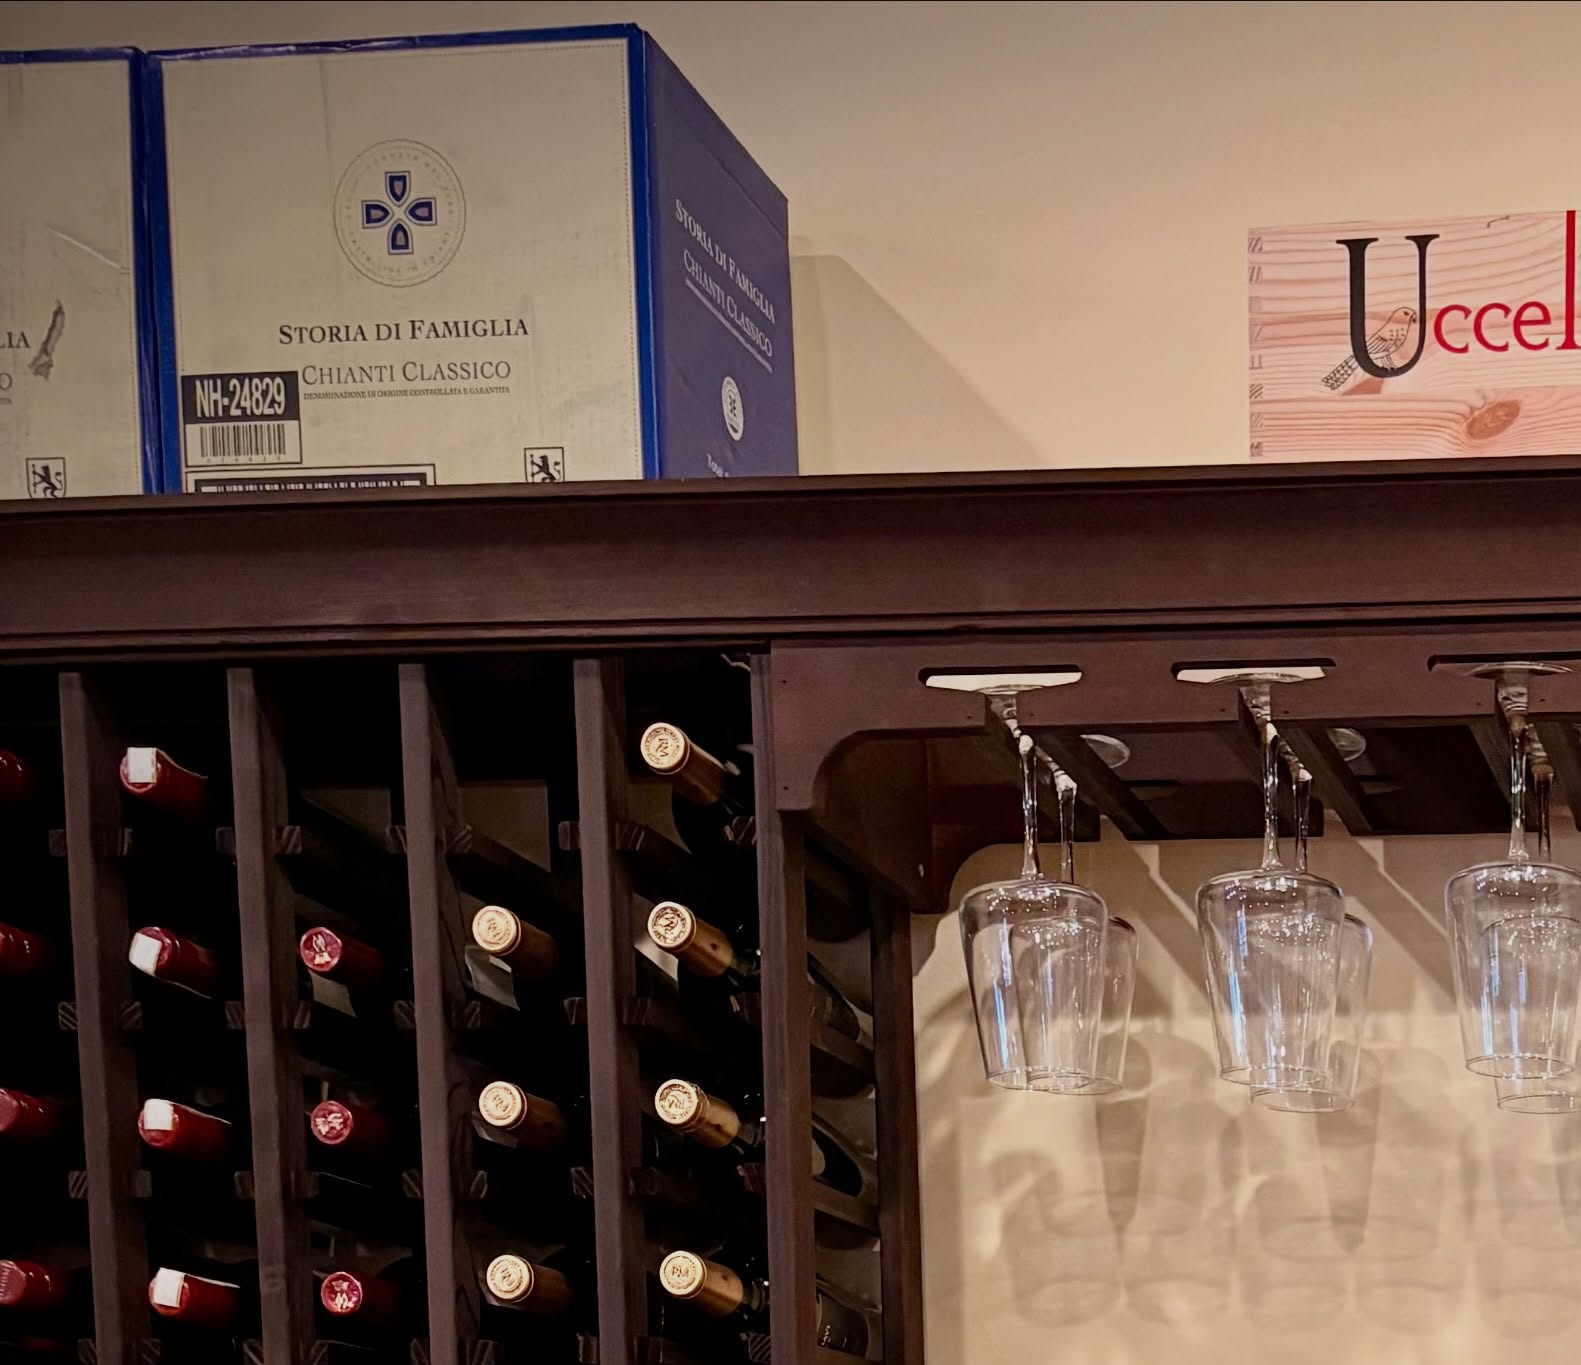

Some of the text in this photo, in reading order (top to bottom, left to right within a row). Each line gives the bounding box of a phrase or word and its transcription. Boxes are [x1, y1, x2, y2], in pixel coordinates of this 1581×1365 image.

[683, 249, 773, 358] CHIANTI CLASSICO
[729, 257, 776, 325] FAMIGLIA
[278, 318, 529, 345] STORIA DI FAMIGLIA
[302, 361, 512, 385] CHIANTI CLASSICO
[195, 377, 287, 419] NH-24829
[303, 391, 367, 401] DENOMINAZIONE
